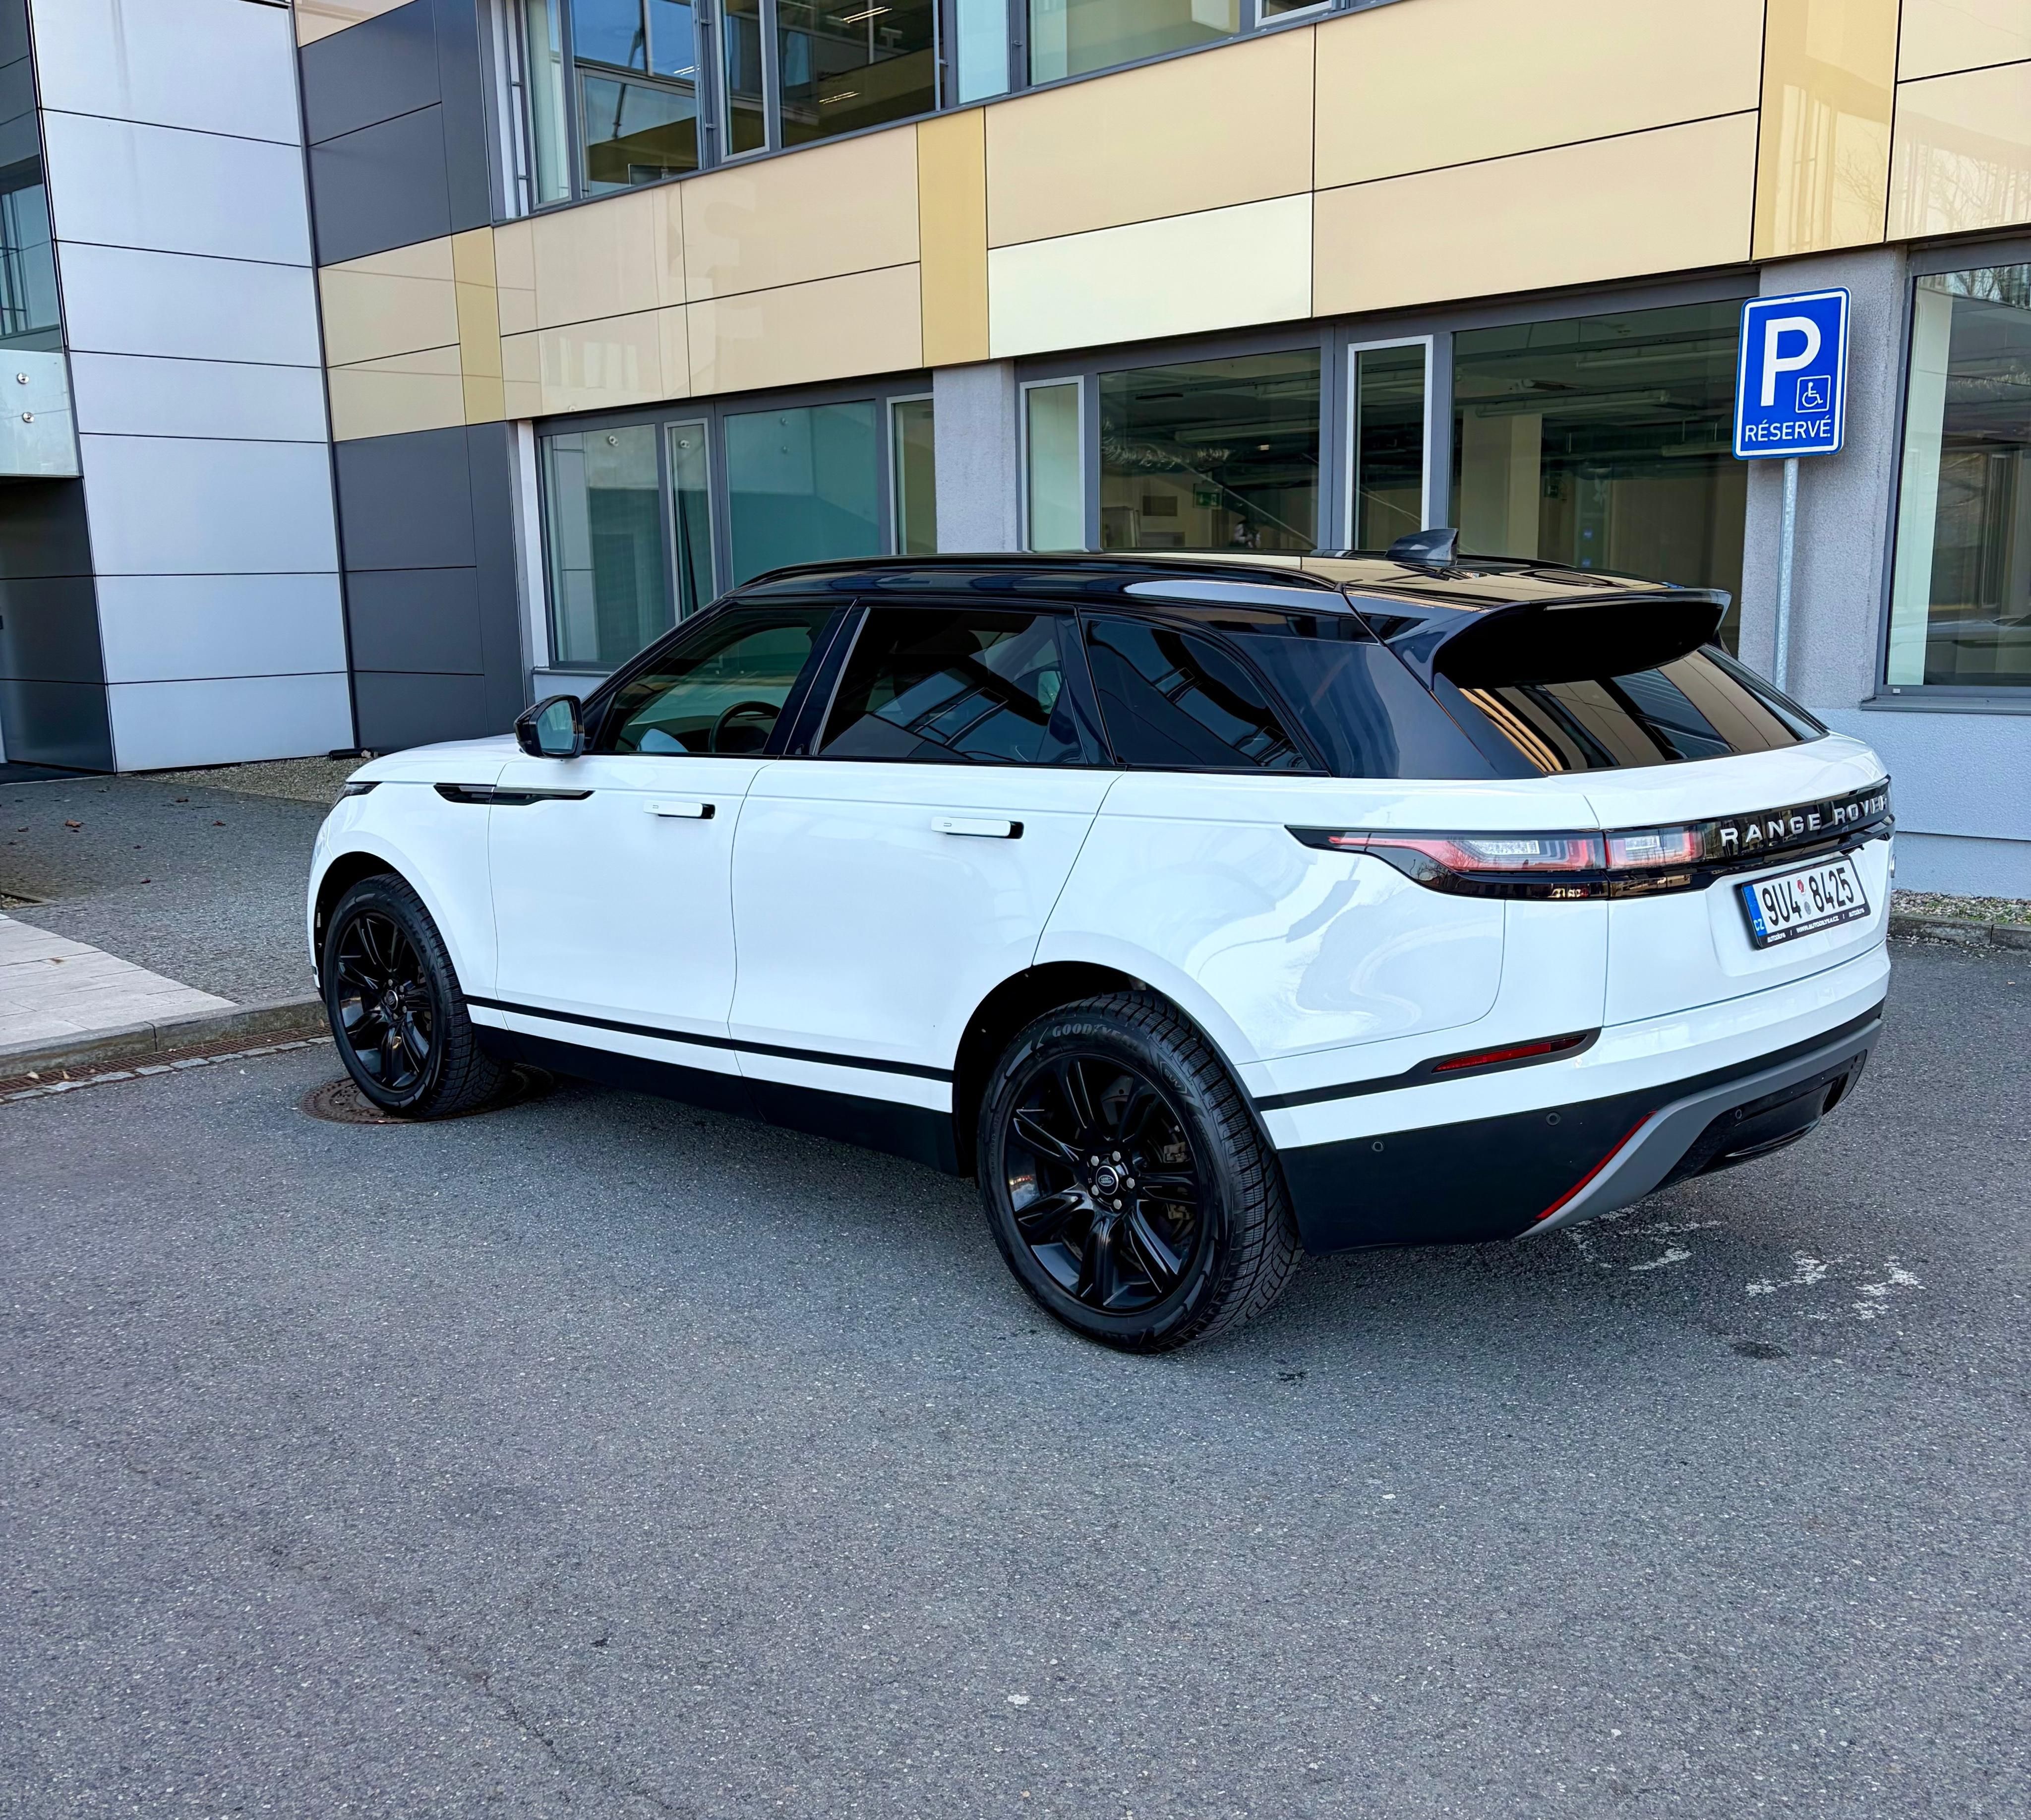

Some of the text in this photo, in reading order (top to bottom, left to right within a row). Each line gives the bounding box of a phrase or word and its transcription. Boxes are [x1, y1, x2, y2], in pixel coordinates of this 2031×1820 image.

[1761, 316, 1821, 407] P
[1745, 415, 1831, 442] RÉSERVÉ
[1720, 794, 1887, 847] RANGE ROVER
[1762, 867, 1854, 926] 9U4 8425
[1754, 918, 1765, 931] CZ
